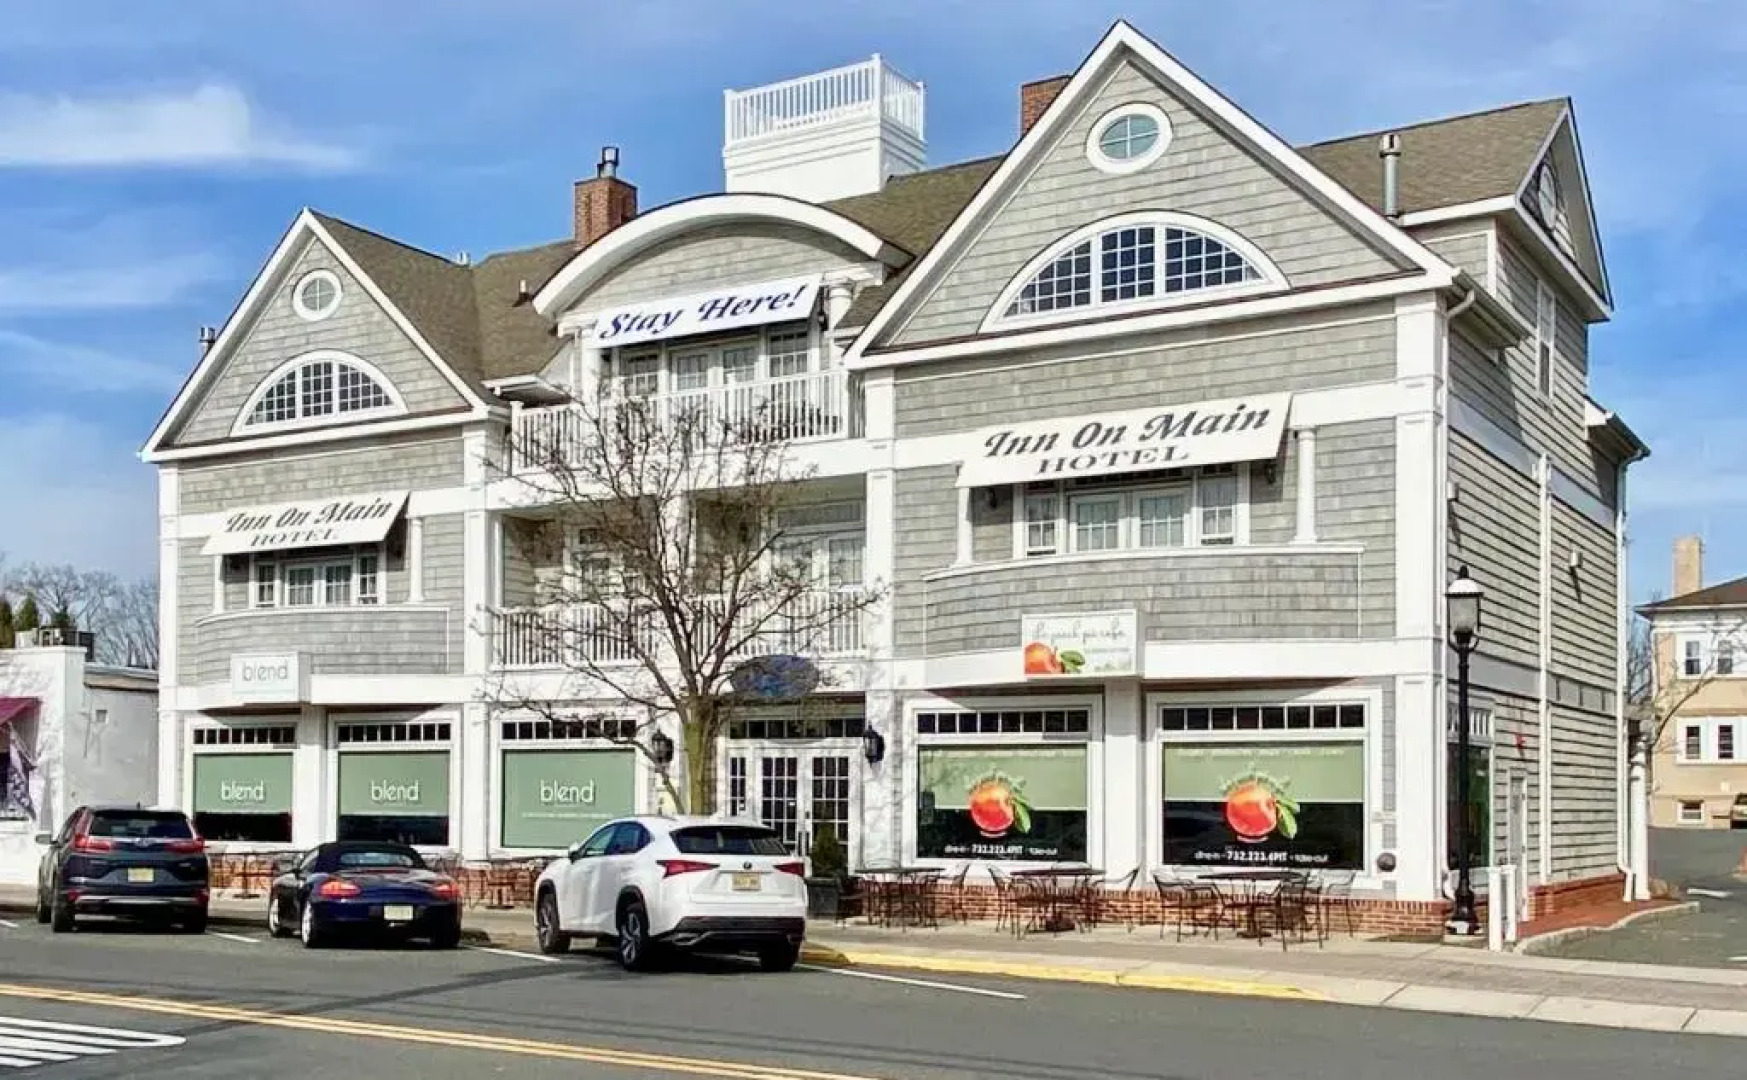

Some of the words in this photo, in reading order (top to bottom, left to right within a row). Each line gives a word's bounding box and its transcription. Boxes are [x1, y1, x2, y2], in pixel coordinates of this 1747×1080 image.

[600, 309, 685, 339] Stay
[699, 284, 809, 321] Here!
[984, 431, 1060, 458] Inn
[1072, 421, 1128, 449] On
[1138, 403, 1271, 441] Main
[1036, 445, 1190, 475] HOTEL
[225, 512, 272, 532] Inn
[275, 507, 312, 528] On
[313, 497, 393, 525] Main
[250, 528, 339, 547] HOTEL
[242, 658, 288, 681] blend
[221, 779, 265, 801] blend
[371, 779, 420, 801] blend
[540, 779, 595, 803] blend
